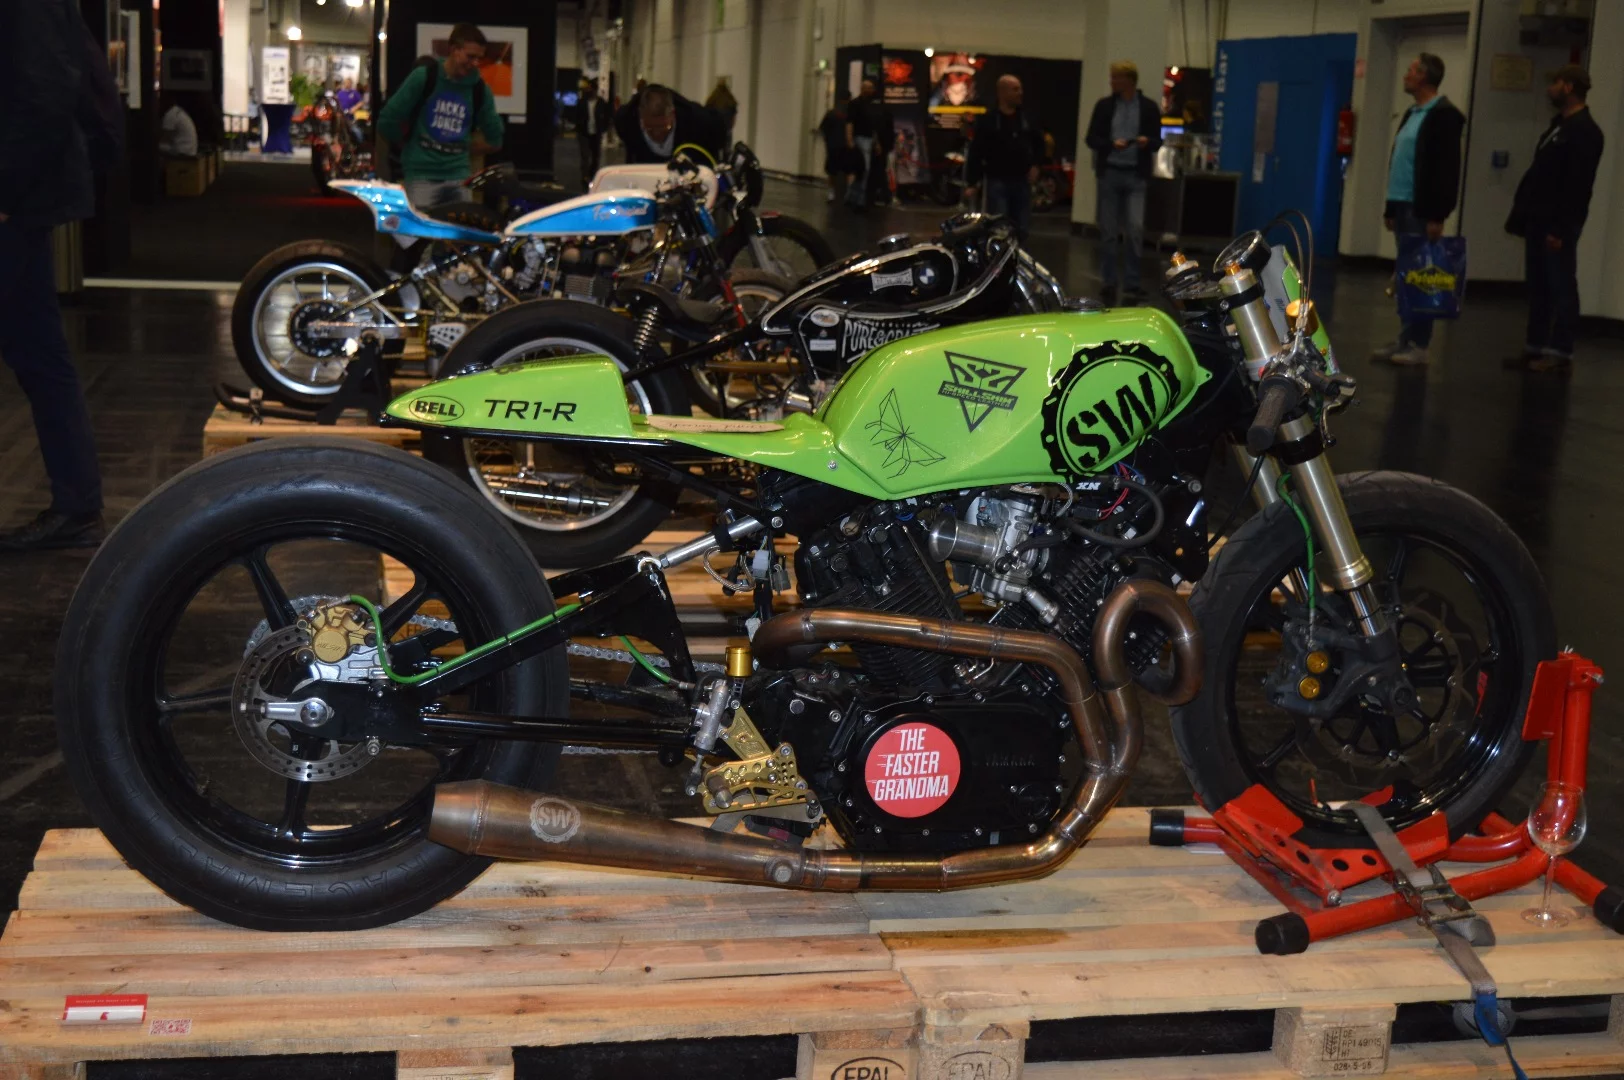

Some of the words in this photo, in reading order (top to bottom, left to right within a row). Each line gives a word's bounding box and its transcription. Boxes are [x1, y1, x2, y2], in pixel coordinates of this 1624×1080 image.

[430, 114, 464, 134] JONES
[414, 400, 458, 417] BELL
[484, 399, 577, 422] TR1-R
[1066, 371, 1157, 469] SW
[899, 728, 927, 752] THE
[884, 751, 940, 777] FASTER
[874, 775, 949, 801] GRANDMA
[538, 806, 572, 829] SW
